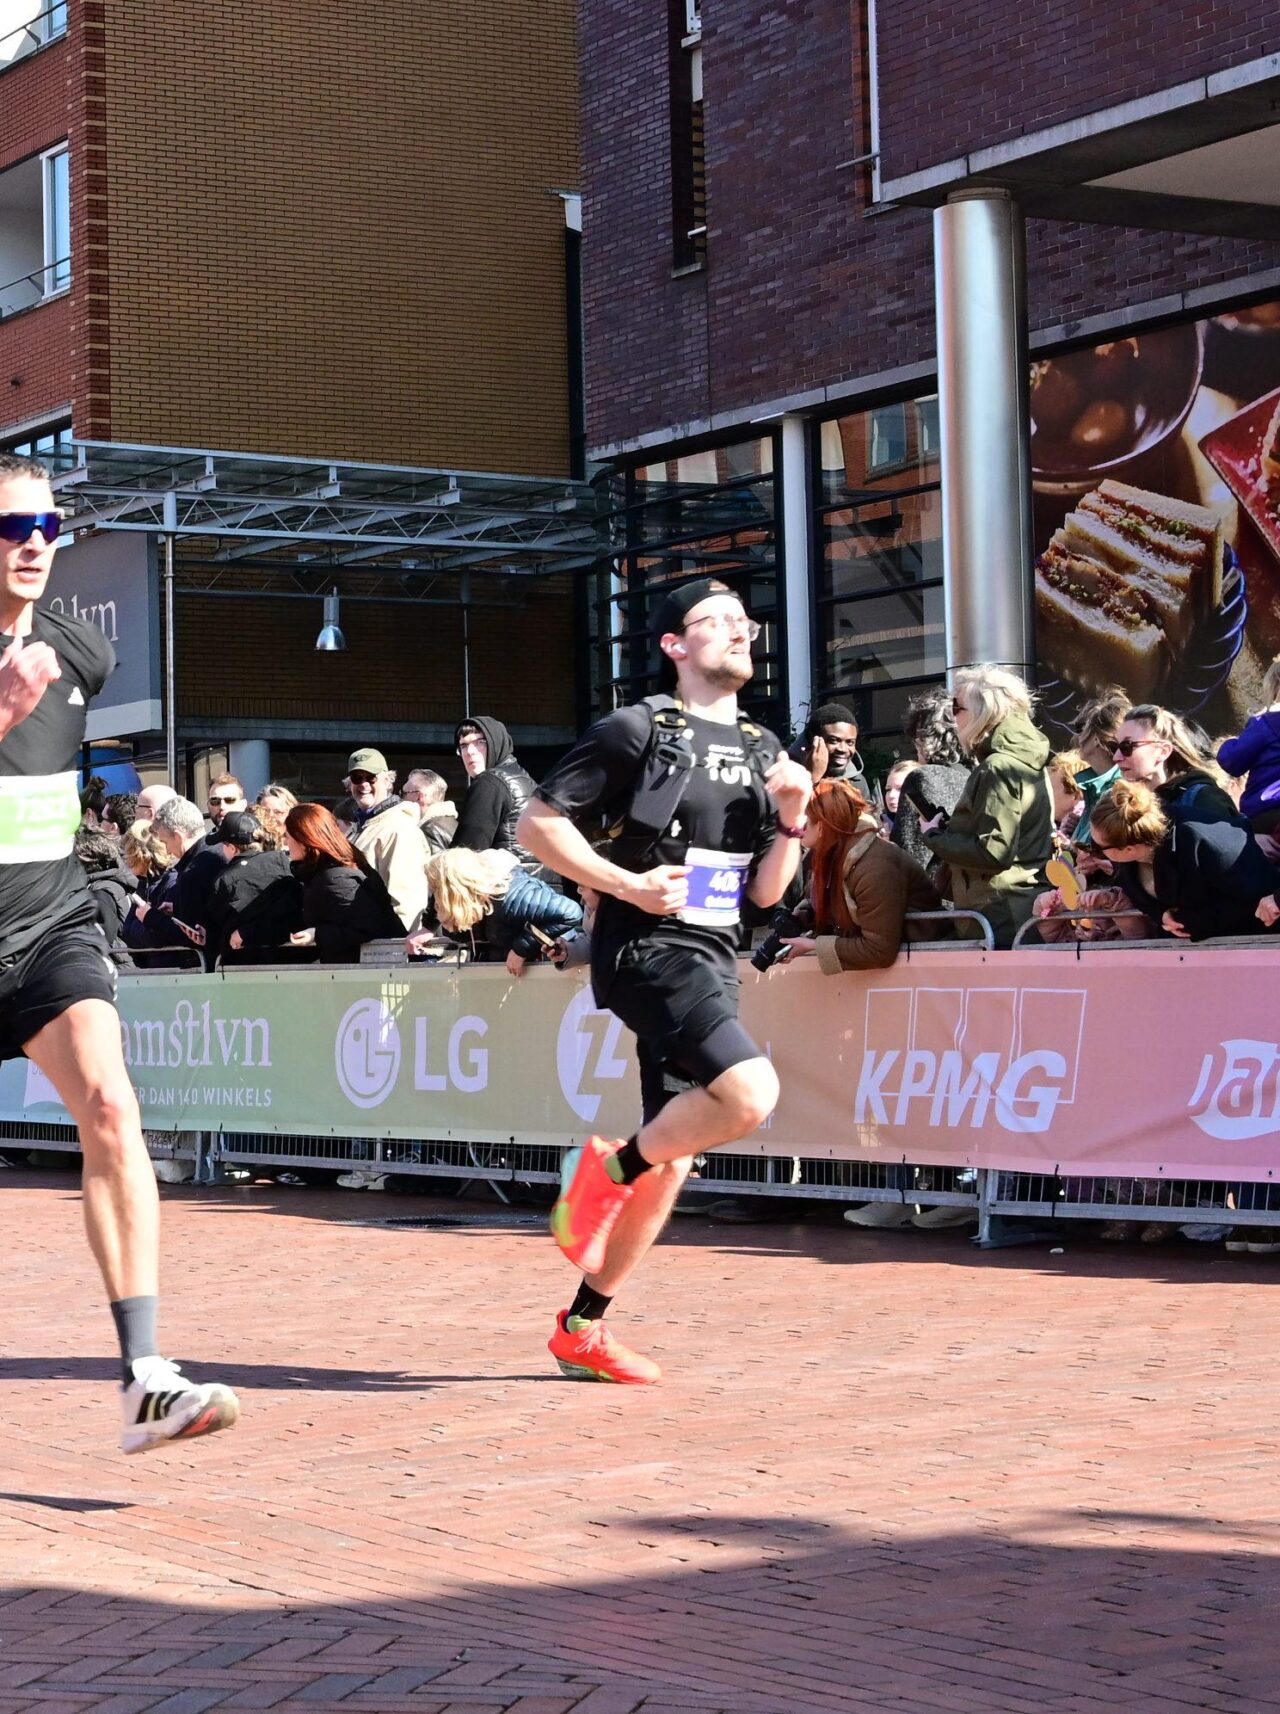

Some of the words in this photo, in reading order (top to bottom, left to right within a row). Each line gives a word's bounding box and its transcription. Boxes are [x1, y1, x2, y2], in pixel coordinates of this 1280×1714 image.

[414, 1014, 489, 1093] LG
[853, 1050, 1067, 1133] KPMG
[150, 1088, 175, 1105] DAN
[178, 1089, 198, 1106] 140
[203, 1088, 272, 1108] WINKELS
